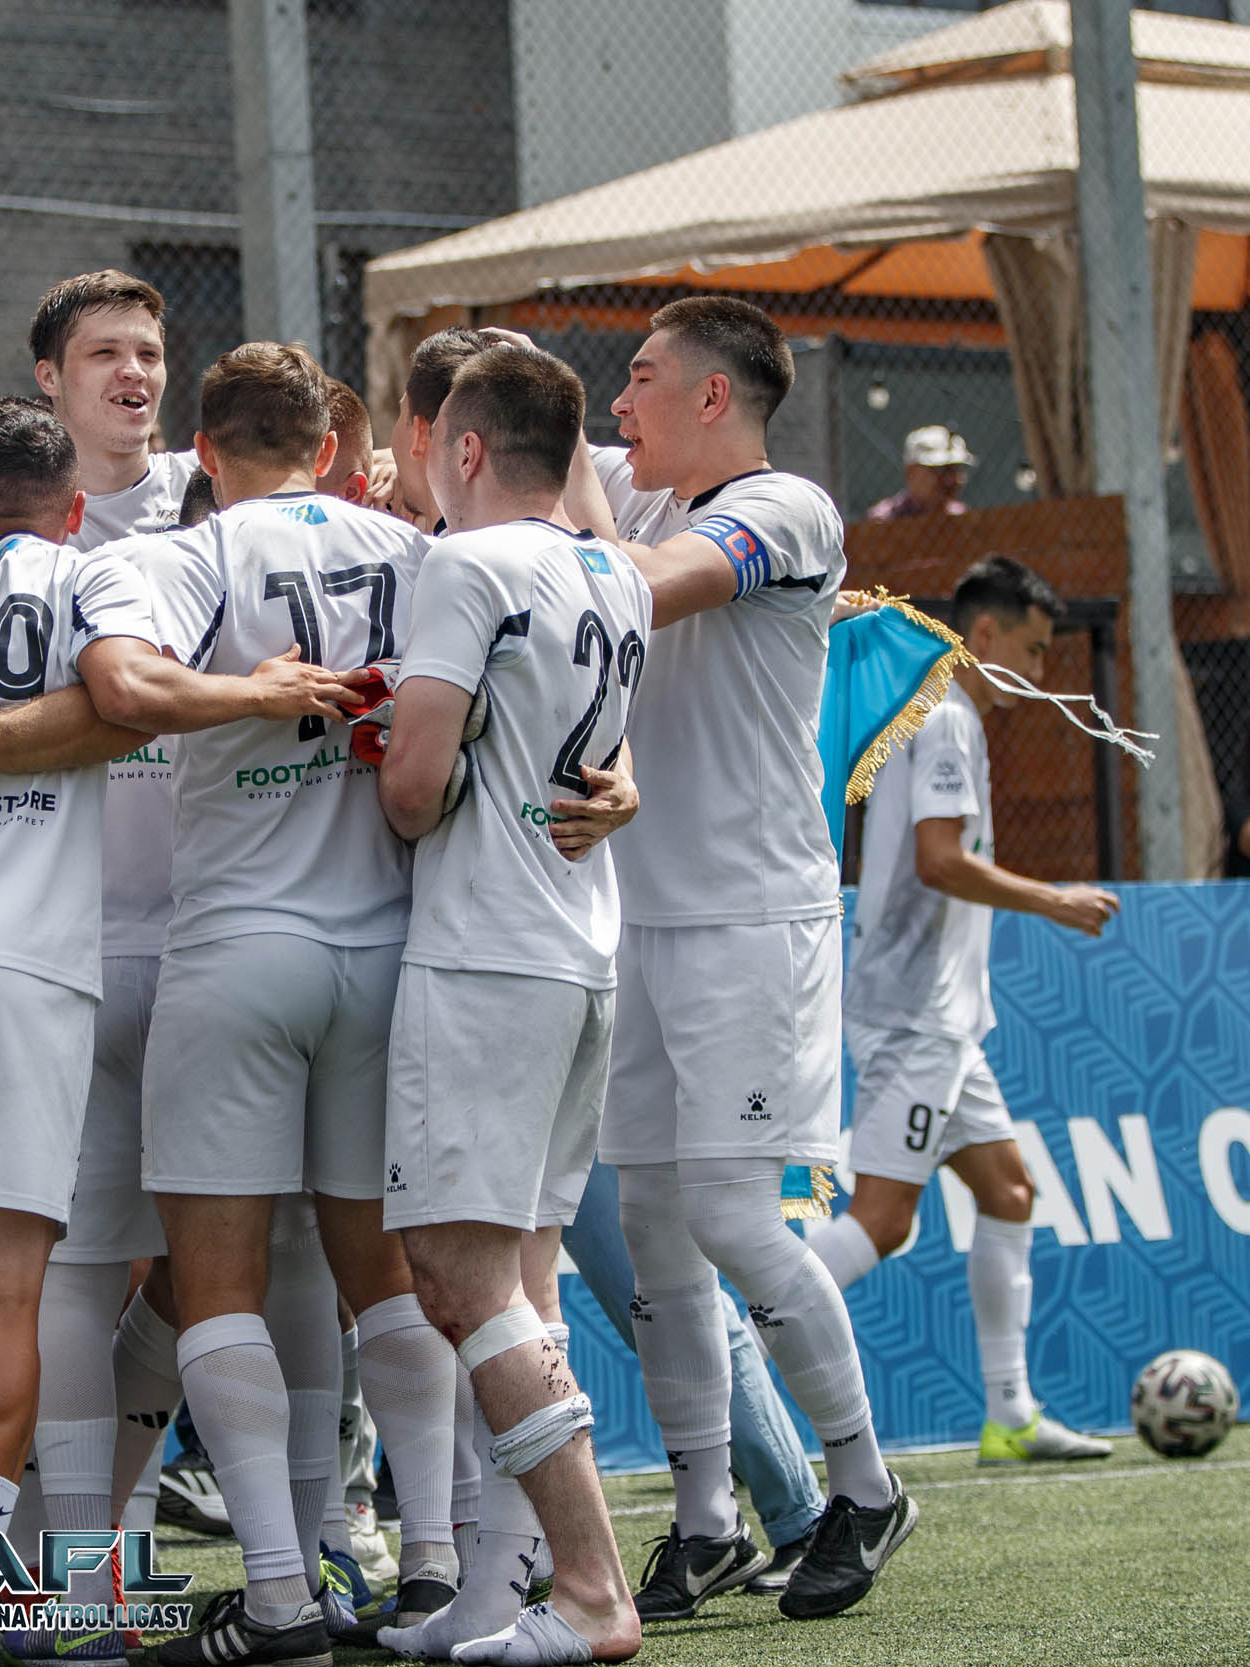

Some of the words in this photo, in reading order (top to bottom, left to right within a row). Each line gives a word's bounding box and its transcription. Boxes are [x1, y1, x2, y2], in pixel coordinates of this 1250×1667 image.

[264, 562, 396, 742] 17
[236, 745, 347, 788] FOOTALL
[740, 1112, 773, 1121] KELME
